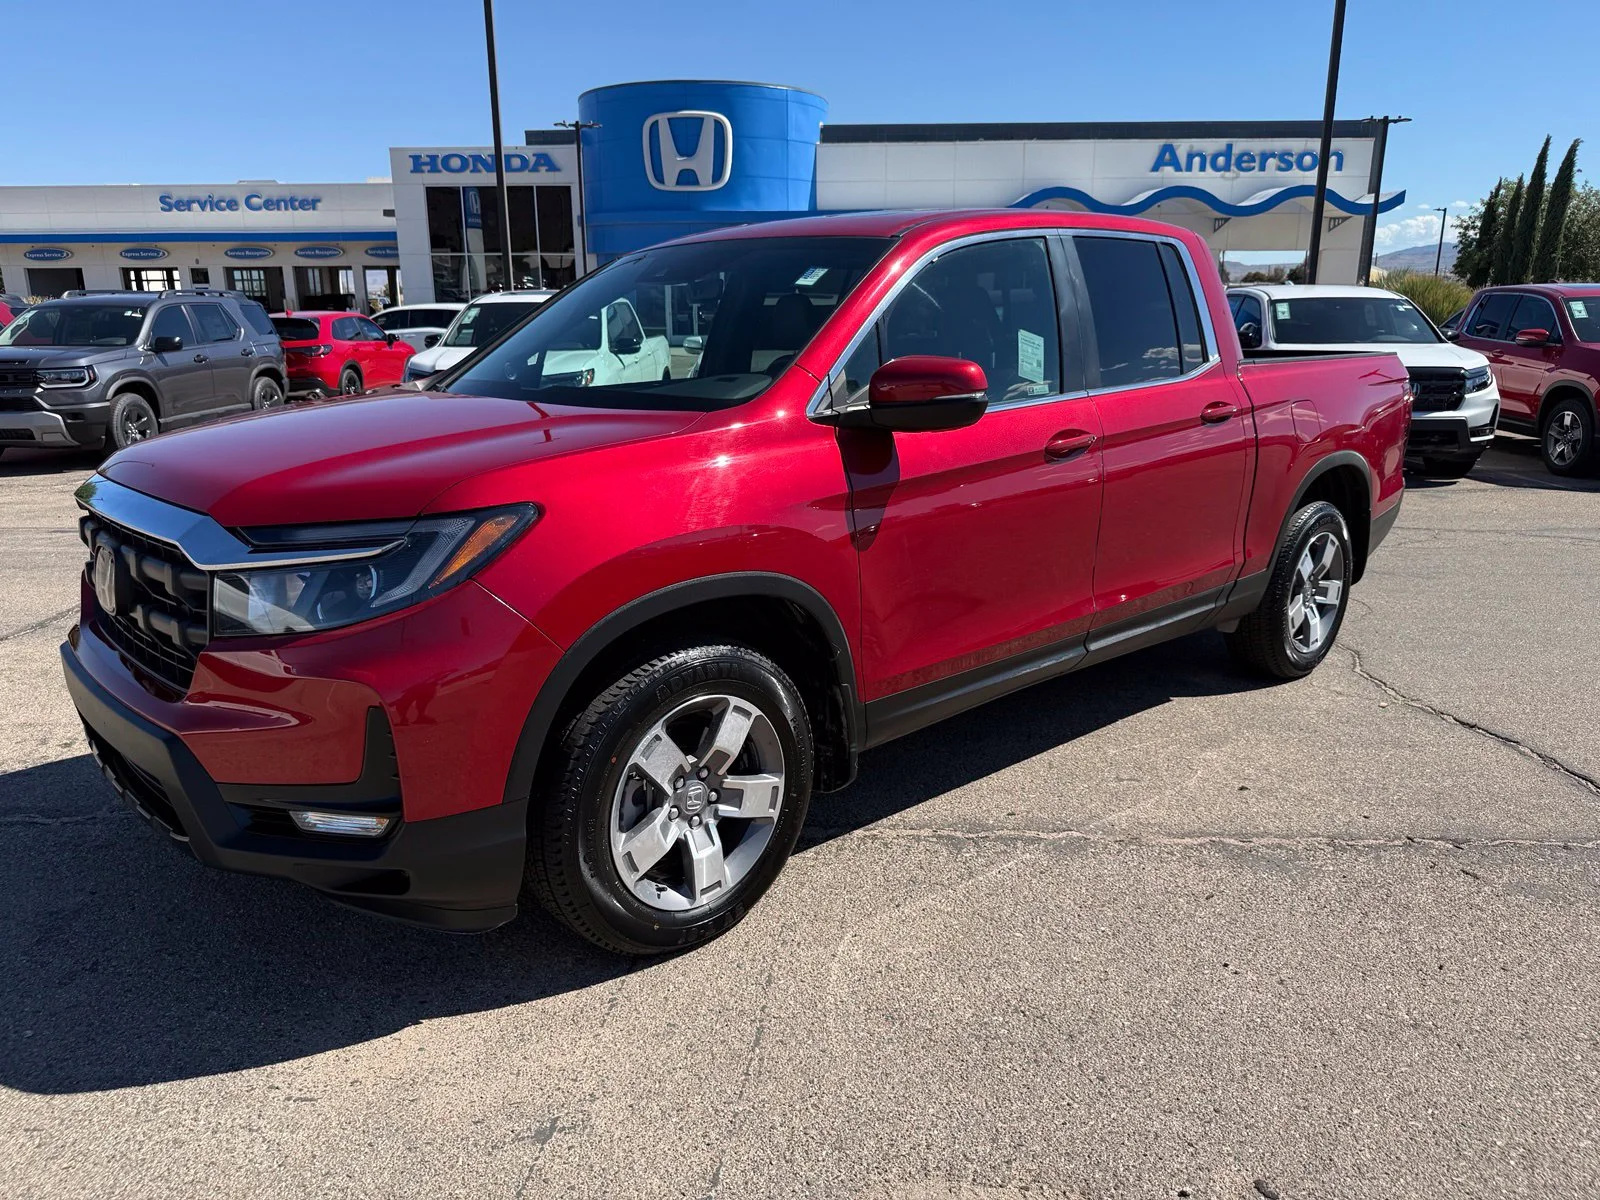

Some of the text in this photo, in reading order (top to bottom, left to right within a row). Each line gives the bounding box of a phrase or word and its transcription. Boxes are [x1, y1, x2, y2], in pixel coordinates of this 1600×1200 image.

[408, 153, 562, 174] HONDA
[1150, 143, 1345, 172] Anderson
[158, 192, 323, 213] Service Center
[121, 251, 140, 259] Express
[315, 249, 340, 257] Reception
